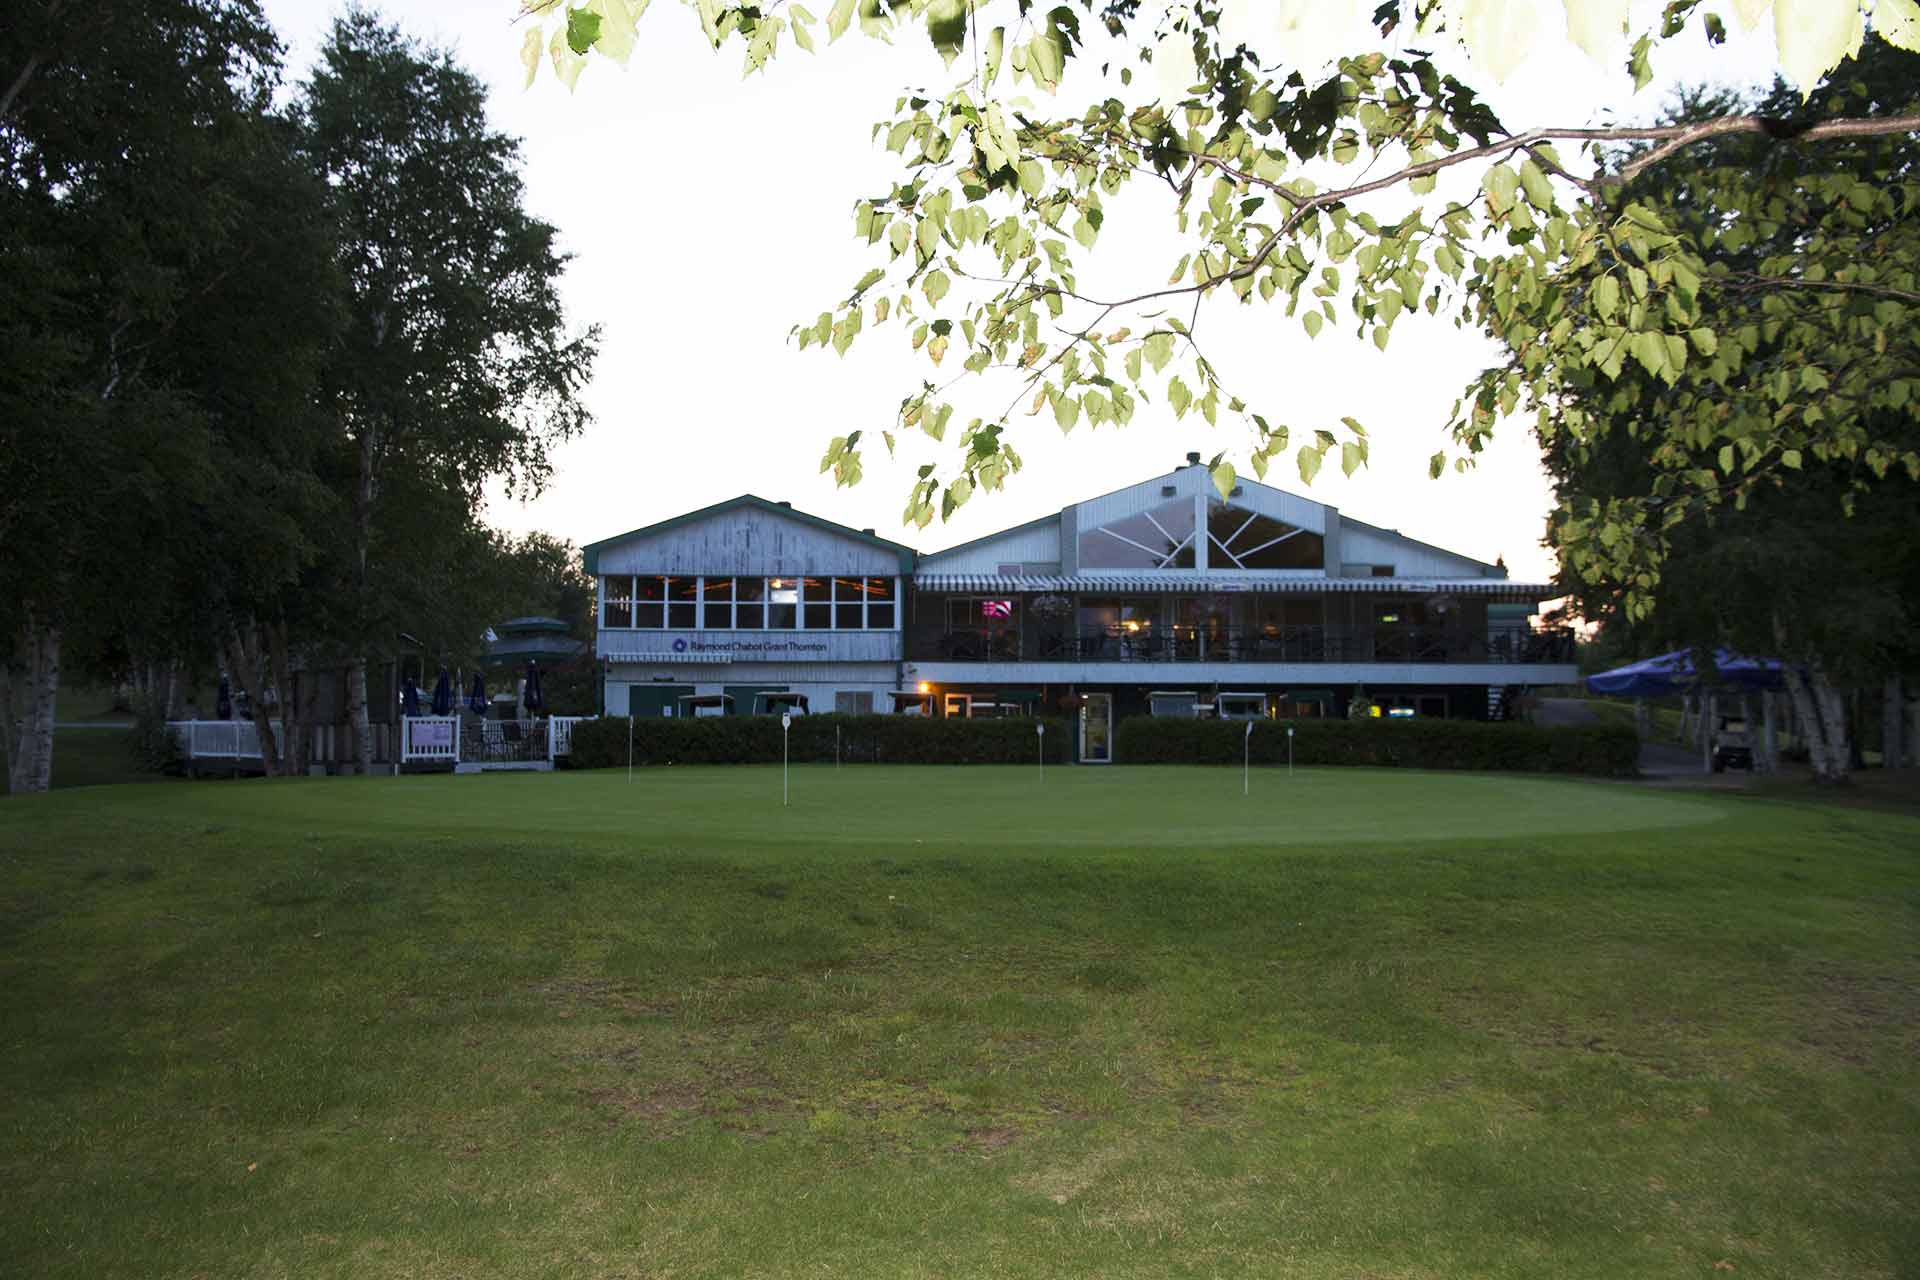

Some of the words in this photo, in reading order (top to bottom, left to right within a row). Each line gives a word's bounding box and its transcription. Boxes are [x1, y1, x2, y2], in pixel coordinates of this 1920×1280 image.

[690, 641, 730, 652] Raymond
[732, 641, 762, 651] Chabot
[763, 641, 787, 651] Grant
[789, 641, 827, 651] Thornton
